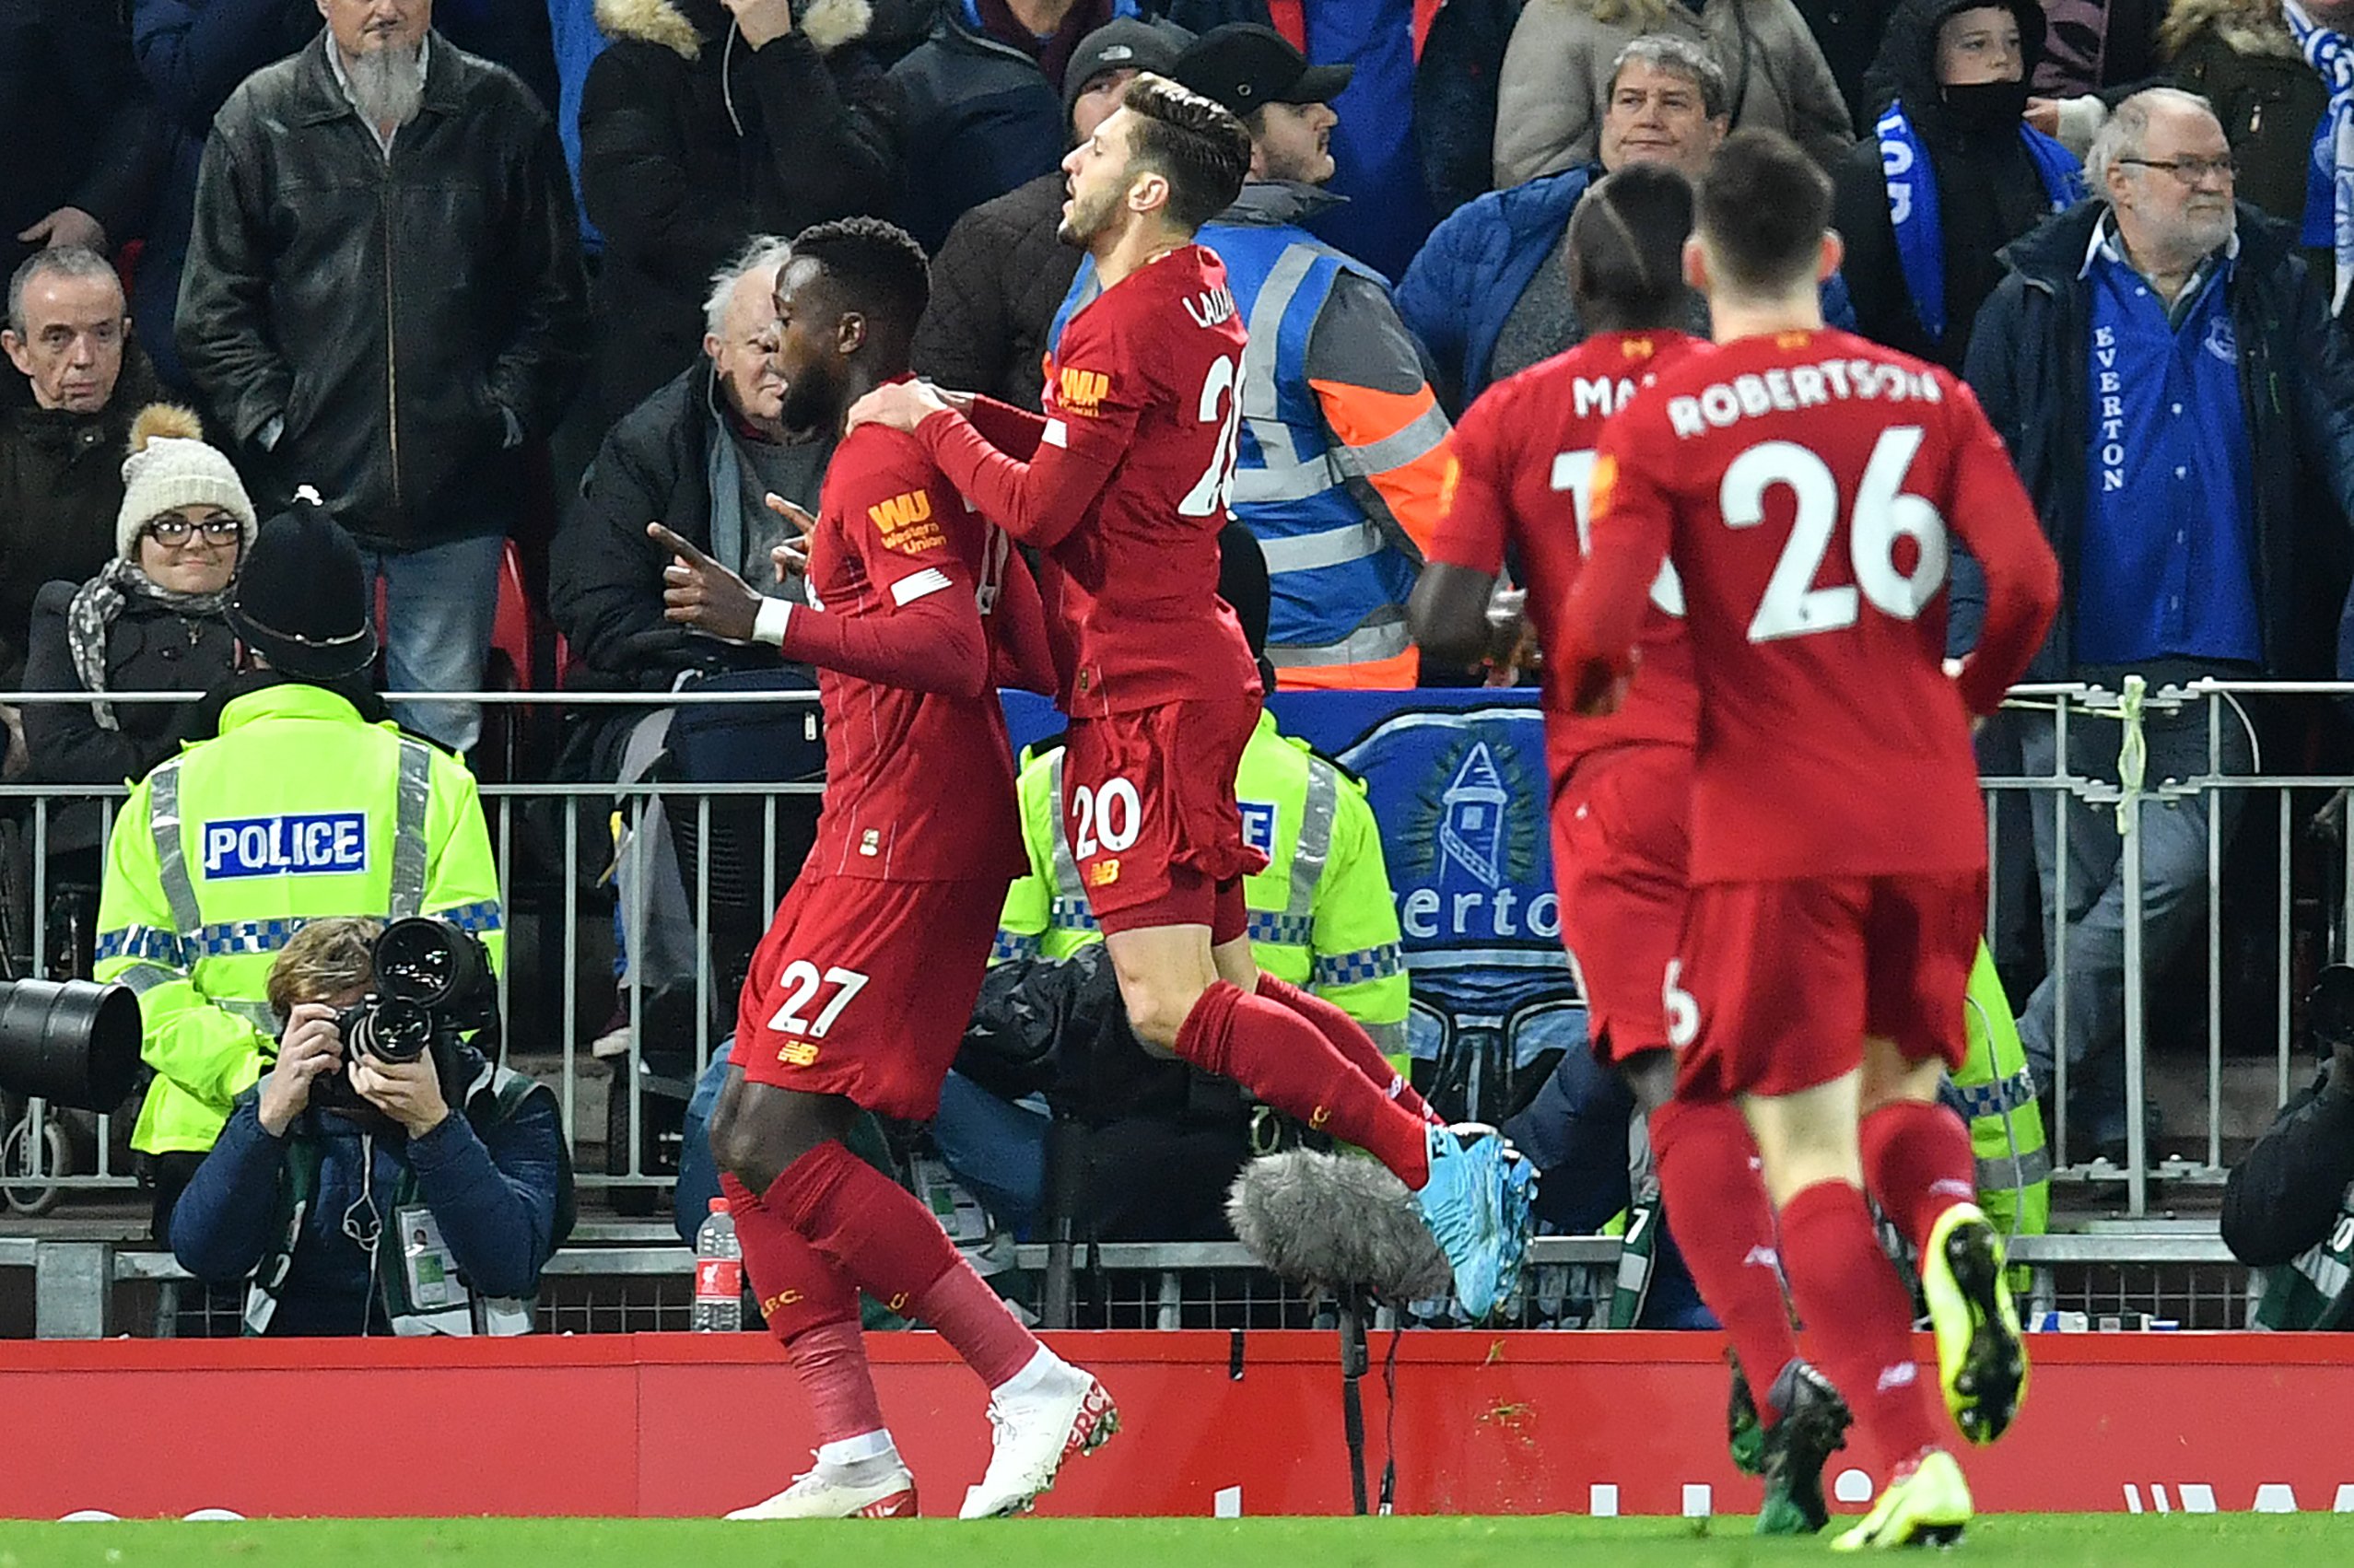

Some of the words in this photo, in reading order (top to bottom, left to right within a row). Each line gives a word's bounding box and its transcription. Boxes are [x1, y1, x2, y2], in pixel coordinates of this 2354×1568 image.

[1060, 368, 1109, 400] WU
[1573, 374, 1657, 418] MA
[1667, 359, 1942, 439] ROBERTSON
[2095, 326, 2125, 491] EVERTON
[868, 489, 931, 534] WU
[881, 522, 940, 549] Western
[1719, 426, 1952, 643] 26
[903, 535, 947, 555] Union
[1072, 777, 1141, 860] 20
[205, 819, 362, 870] POLICE
[1403, 887, 1560, 938] erto
[767, 959, 870, 1039] 27
